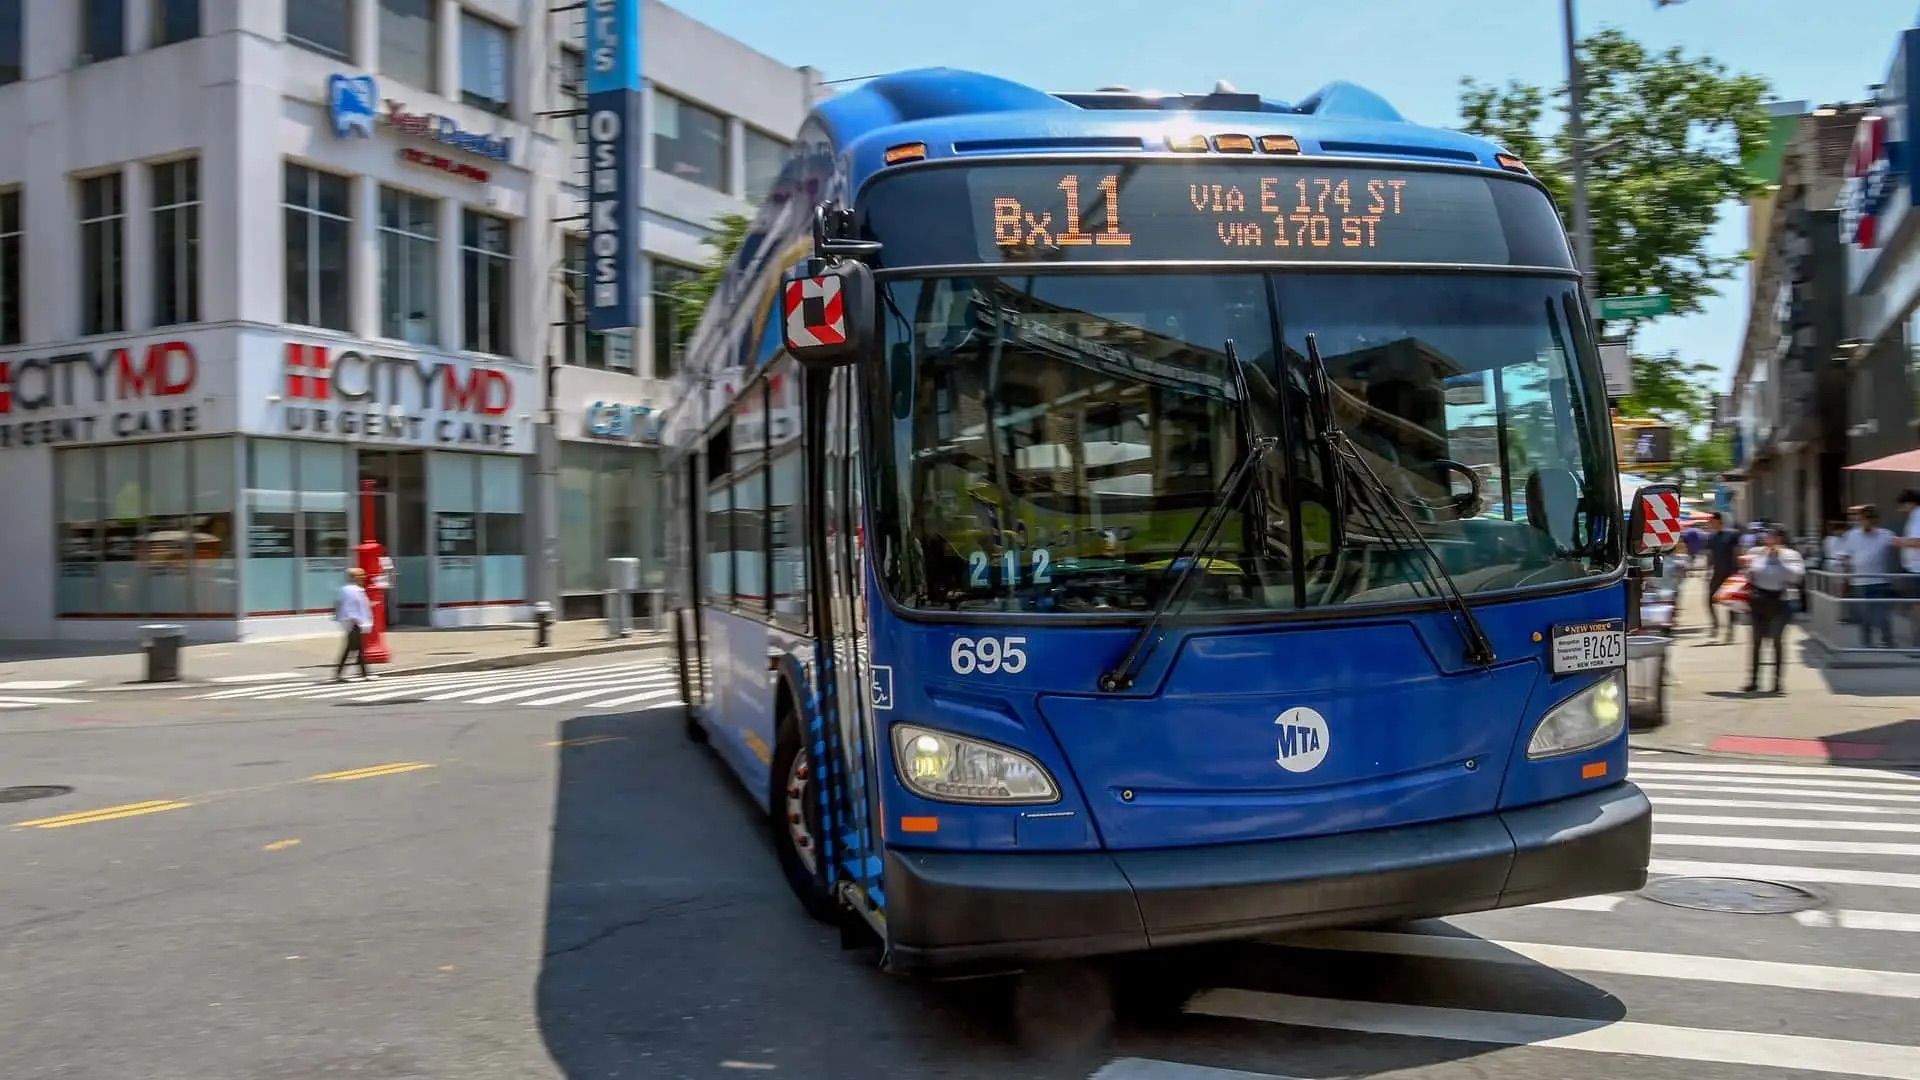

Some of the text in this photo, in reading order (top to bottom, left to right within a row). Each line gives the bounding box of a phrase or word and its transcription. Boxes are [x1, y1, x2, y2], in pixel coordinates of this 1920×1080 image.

[994, 175, 1131, 245] Bx11
[1190, 177, 1406, 214] VIA E 174 ST
[1218, 214, 1381, 247] VIA 170 ST
[14, 341, 198, 410] CITYMD
[333, 350, 514, 415] CITYMD
[115, 406, 198, 436] CARE
[286, 406, 513, 446] URGENT CARE
[1570, 623, 1608, 634] NEW YORK
[951, 636, 1027, 675] 695
[1275, 723, 1321, 761] MTA
